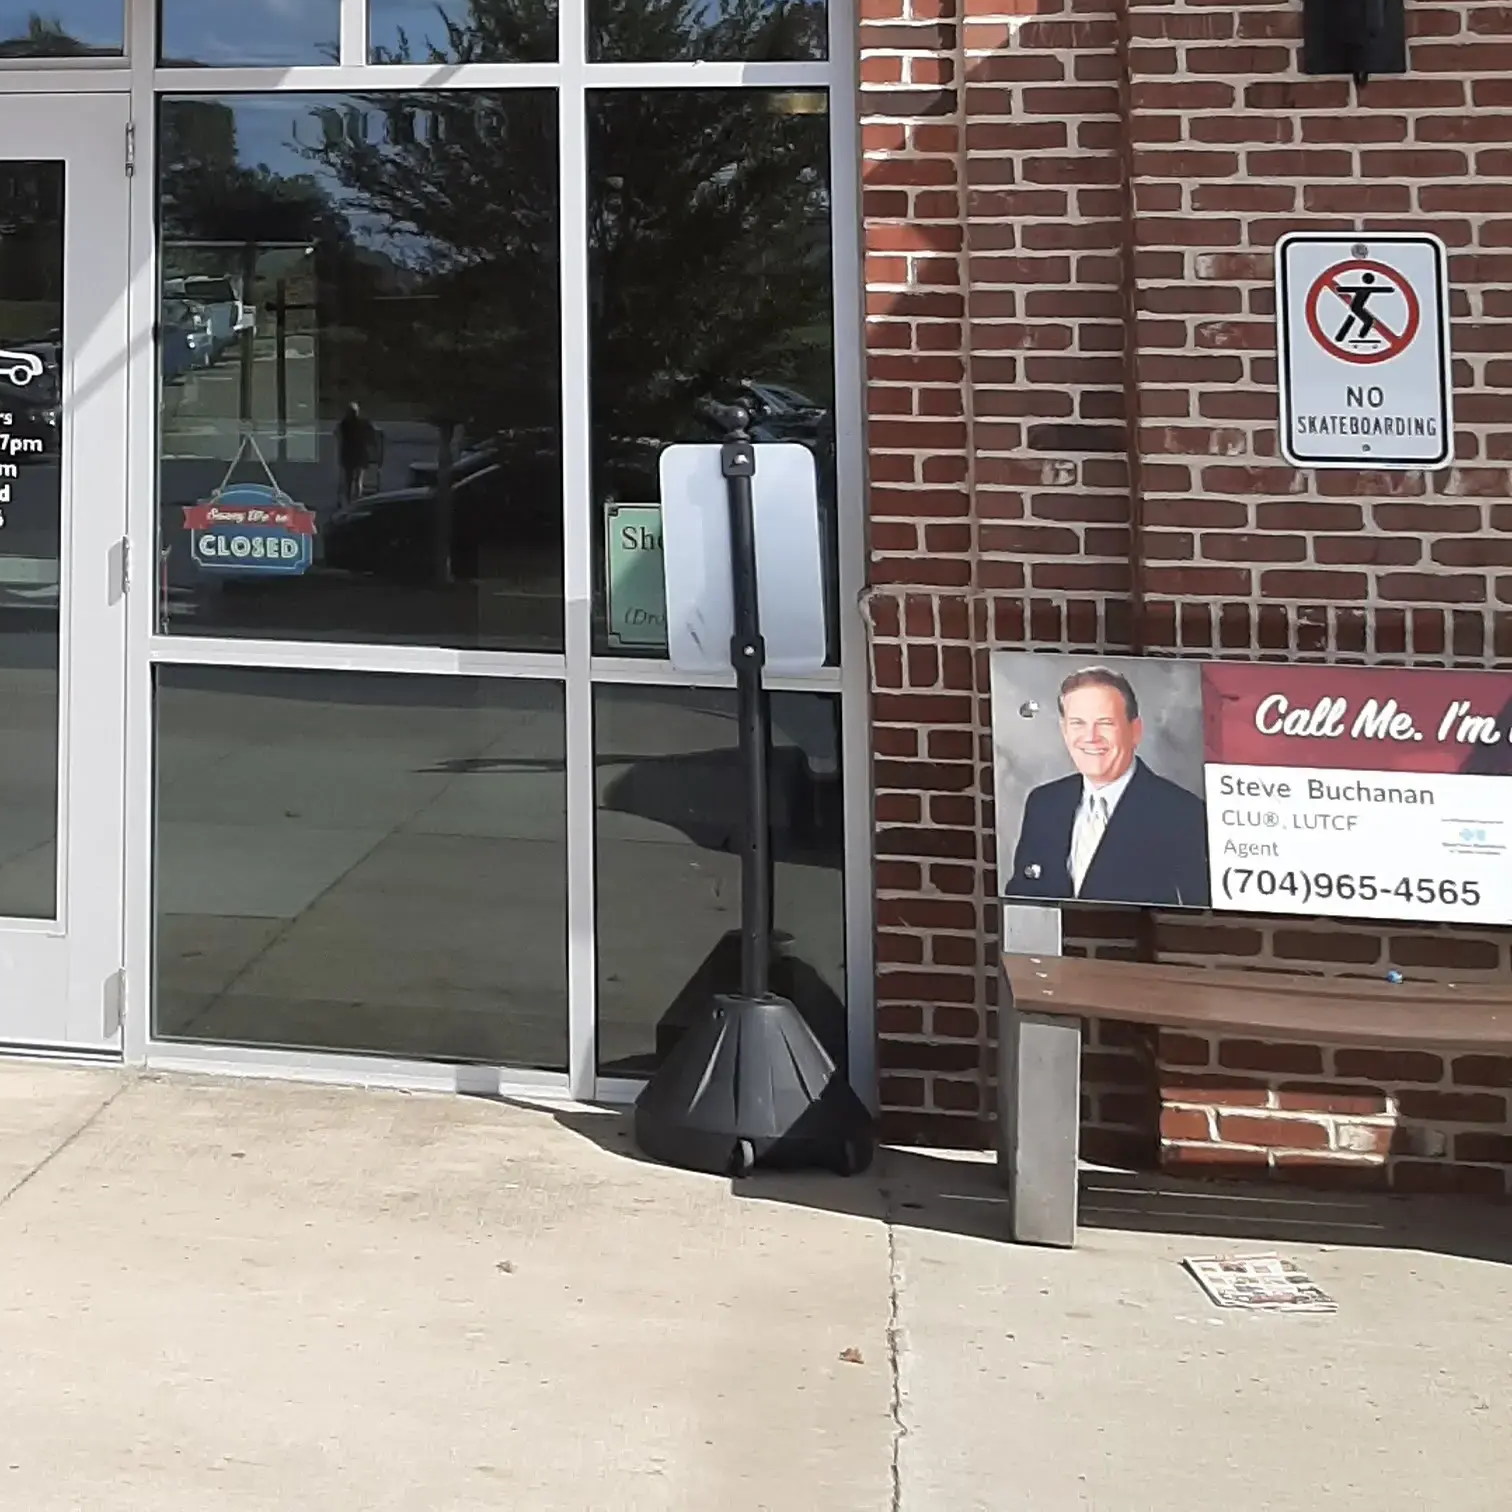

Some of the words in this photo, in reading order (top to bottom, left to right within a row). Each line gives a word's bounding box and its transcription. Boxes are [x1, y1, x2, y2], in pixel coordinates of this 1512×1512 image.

[1346, 386, 1384, 407] NO
[1298, 416, 1437, 437] SKATEBOARDING
[0, 434, 43, 455] 7pm
[199, 534, 299, 559] CLOSED
[1254, 693, 1347, 738] Call
[1350, 699, 1424, 742] Me.
[1437, 700, 1501, 745] I'm
[1220, 775, 1292, 799] Steve
[1308, 779, 1435, 806] Buchanan
[1293, 813, 1358, 832] LUTCF
[1223, 838, 1280, 858] Agent
[1222, 867, 1481, 906] (704)965-4565
